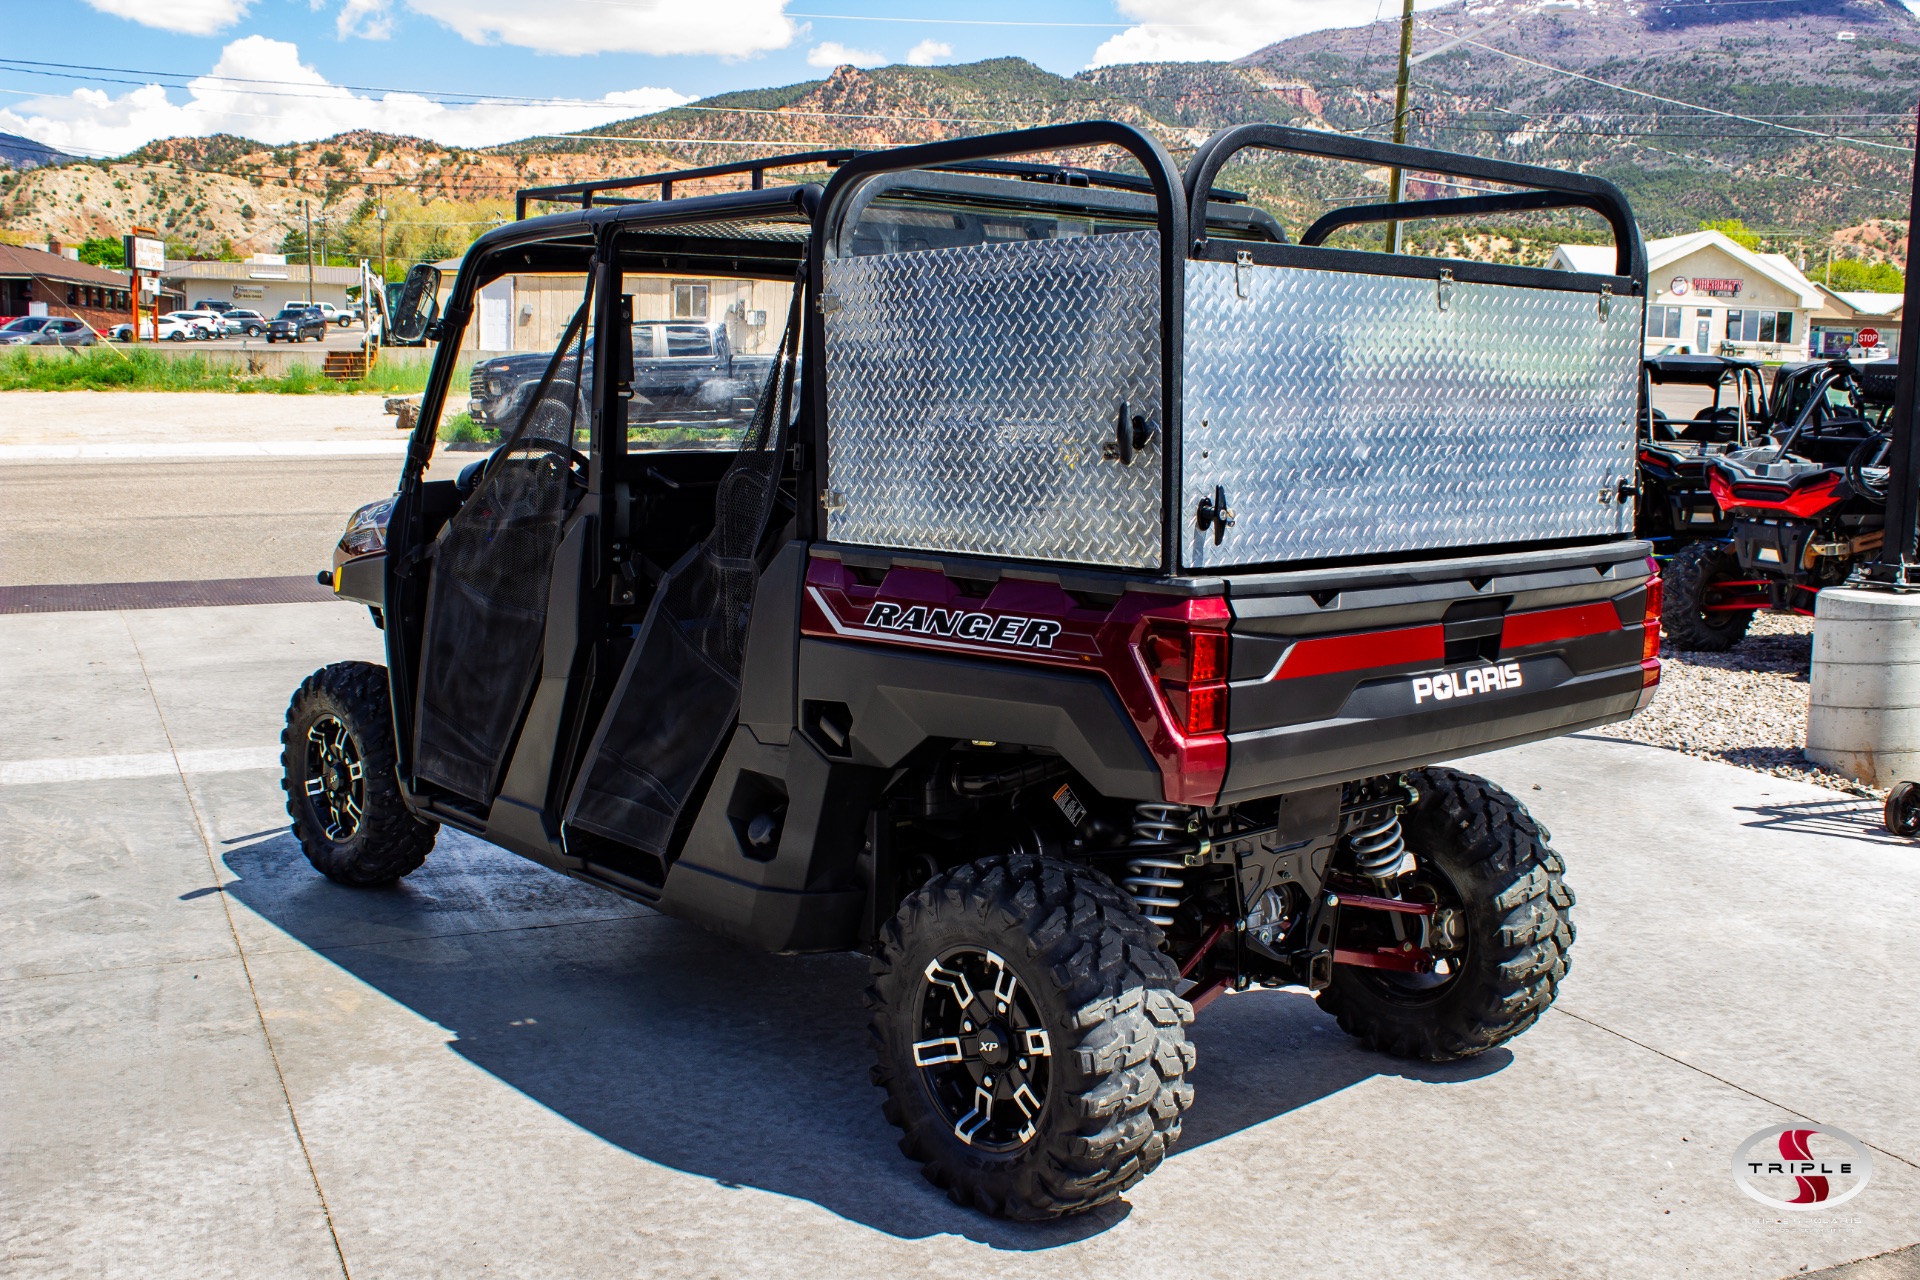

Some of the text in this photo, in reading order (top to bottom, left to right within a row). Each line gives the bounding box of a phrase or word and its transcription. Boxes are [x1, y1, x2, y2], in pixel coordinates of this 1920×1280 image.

[1858, 334, 1878, 342] STOP
[349, 501, 393, 531] XP
[864, 602, 1062, 649] RANGER
[1412, 663, 1523, 704] POLARIS
[979, 1041, 999, 1052] XP
